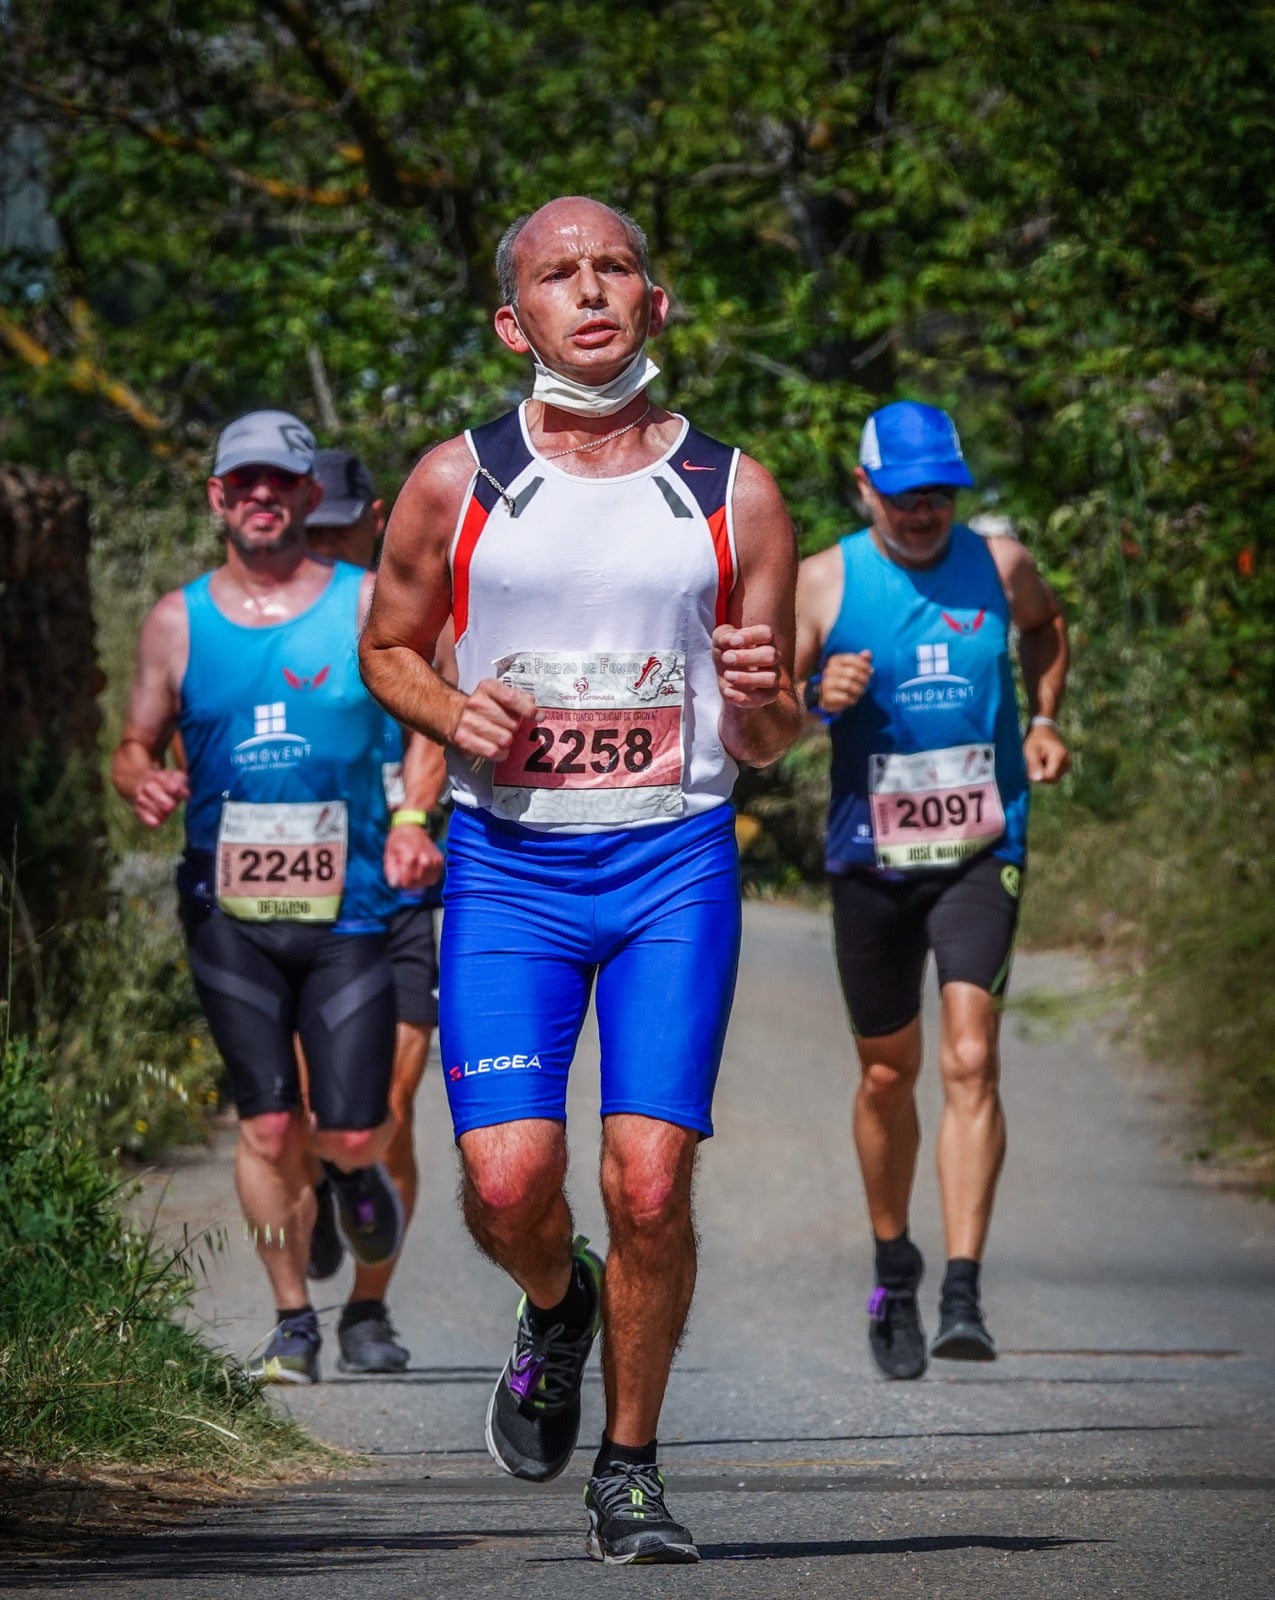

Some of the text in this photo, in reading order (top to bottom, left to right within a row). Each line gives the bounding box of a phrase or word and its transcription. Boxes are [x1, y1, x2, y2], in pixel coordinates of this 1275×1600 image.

[895, 686, 975, 705] INNOVENT
[230, 744, 312, 766] INNOVENT
[524, 727, 653, 774] 2258
[896, 789, 985, 828] 2097
[239, 849, 333, 882] 2248
[464, 1054, 542, 1077] LEGEA
